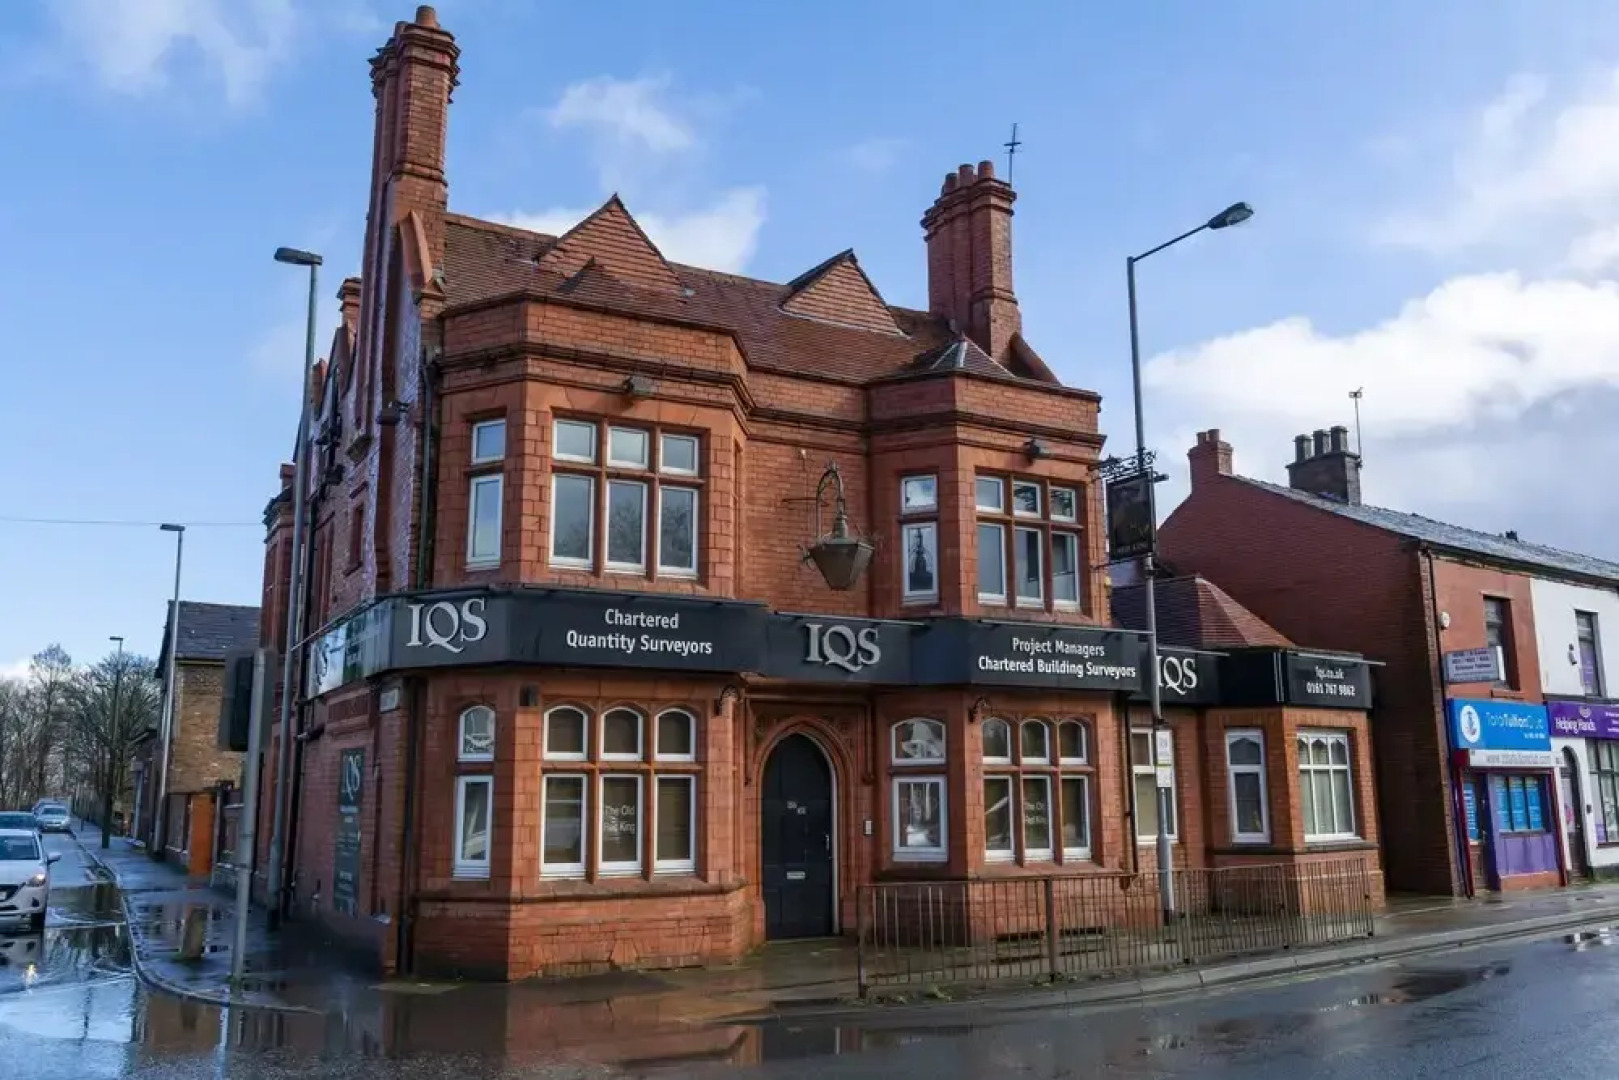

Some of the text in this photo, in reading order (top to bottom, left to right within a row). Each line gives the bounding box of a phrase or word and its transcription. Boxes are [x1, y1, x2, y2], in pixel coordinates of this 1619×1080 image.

[406, 598, 488, 653] IQS
[605, 608, 680, 629] Chartered
[566, 630, 713, 656] Quantity Surveyors
[805, 623, 881, 672] IQS
[1012, 638, 1105, 658] Project Managers
[978, 656, 1136, 680] Chartered Building Surveyors
[1156, 655, 1197, 696] IQS
[1555, 717, 1578, 734] Helping
